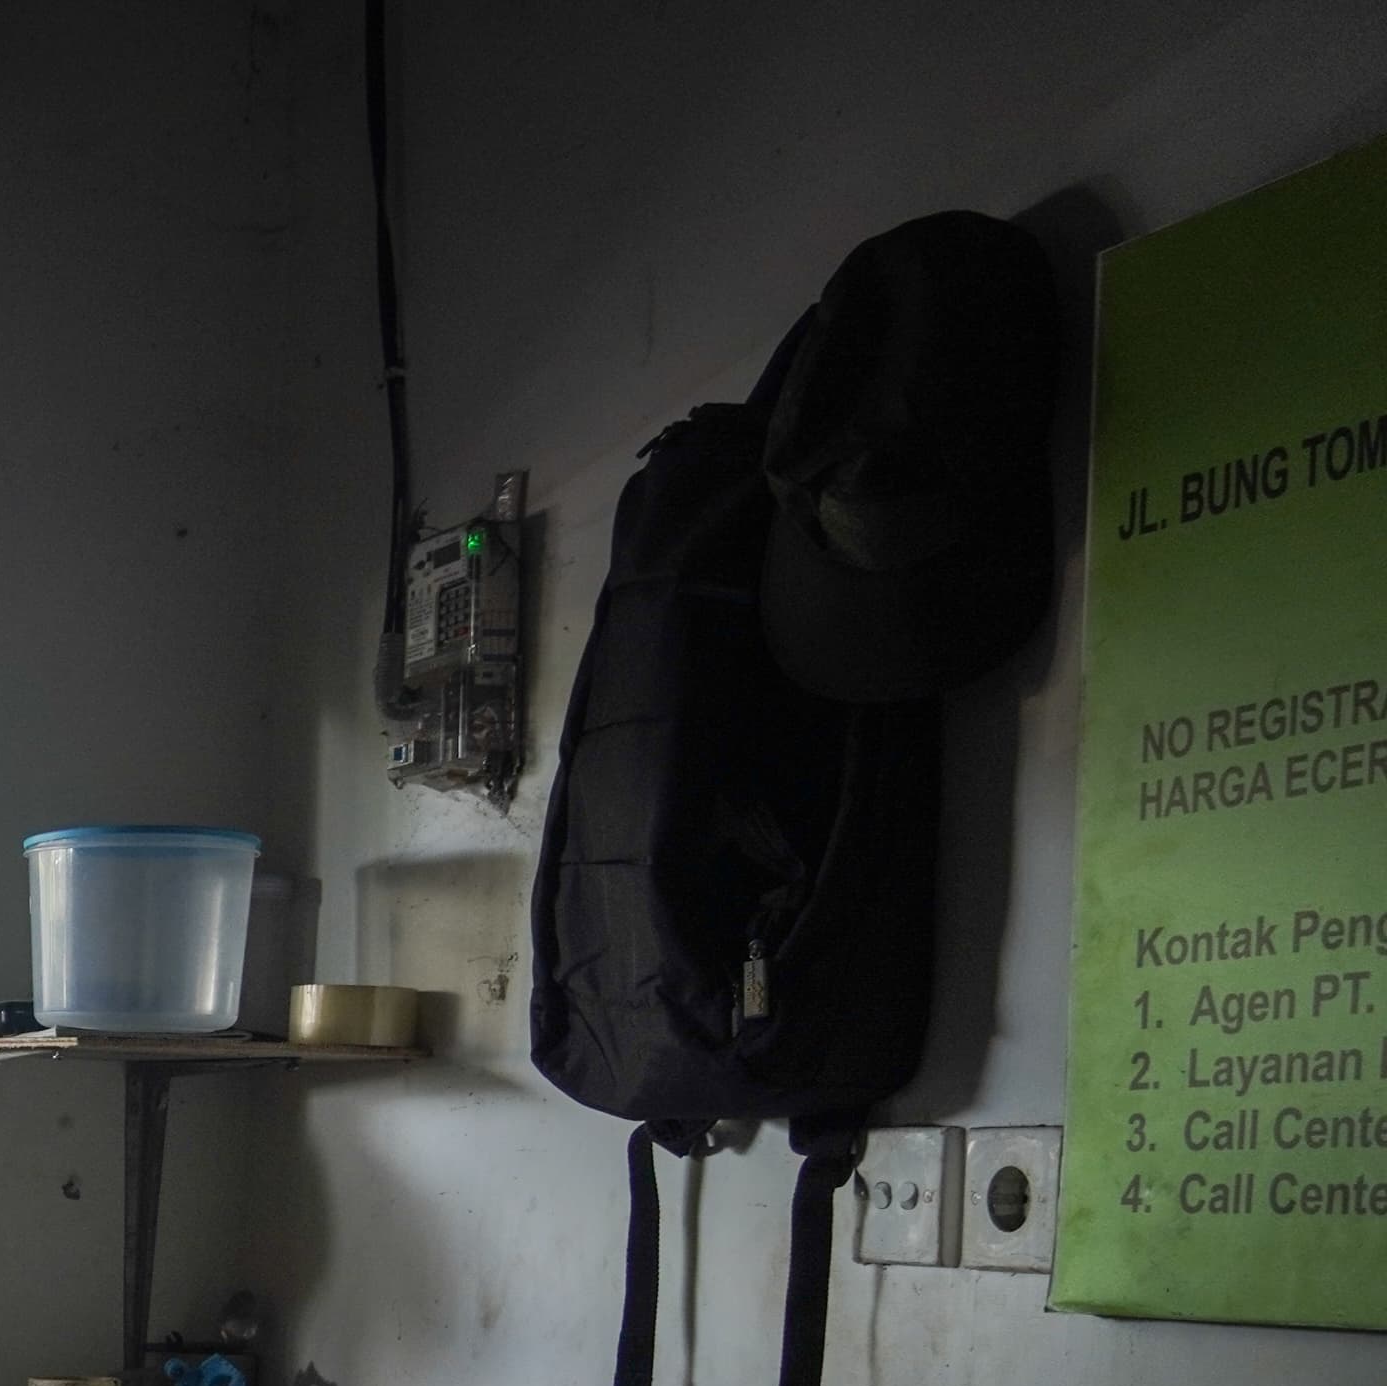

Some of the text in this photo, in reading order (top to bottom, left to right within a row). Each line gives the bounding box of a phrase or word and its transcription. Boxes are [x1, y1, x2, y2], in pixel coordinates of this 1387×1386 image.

[1118, 414, 1387, 541] JL. BUNG TOM
[1142, 679, 1387, 763] NO REGISTR
[1139, 761, 1274, 821] HARGA
[1136, 915, 1277, 968] Kontak
[1134, 971, 1374, 1034] 1. Agen PT.
[1128, 1051, 1160, 1091] 2.
[1187, 1046, 1363, 1097] Layanan
[1126, 1113, 1155, 1152] 3.
[1184, 1109, 1259, 1151] Call
[1120, 1174, 1151, 1214] 4.
[1179, 1173, 1254, 1215] Call
